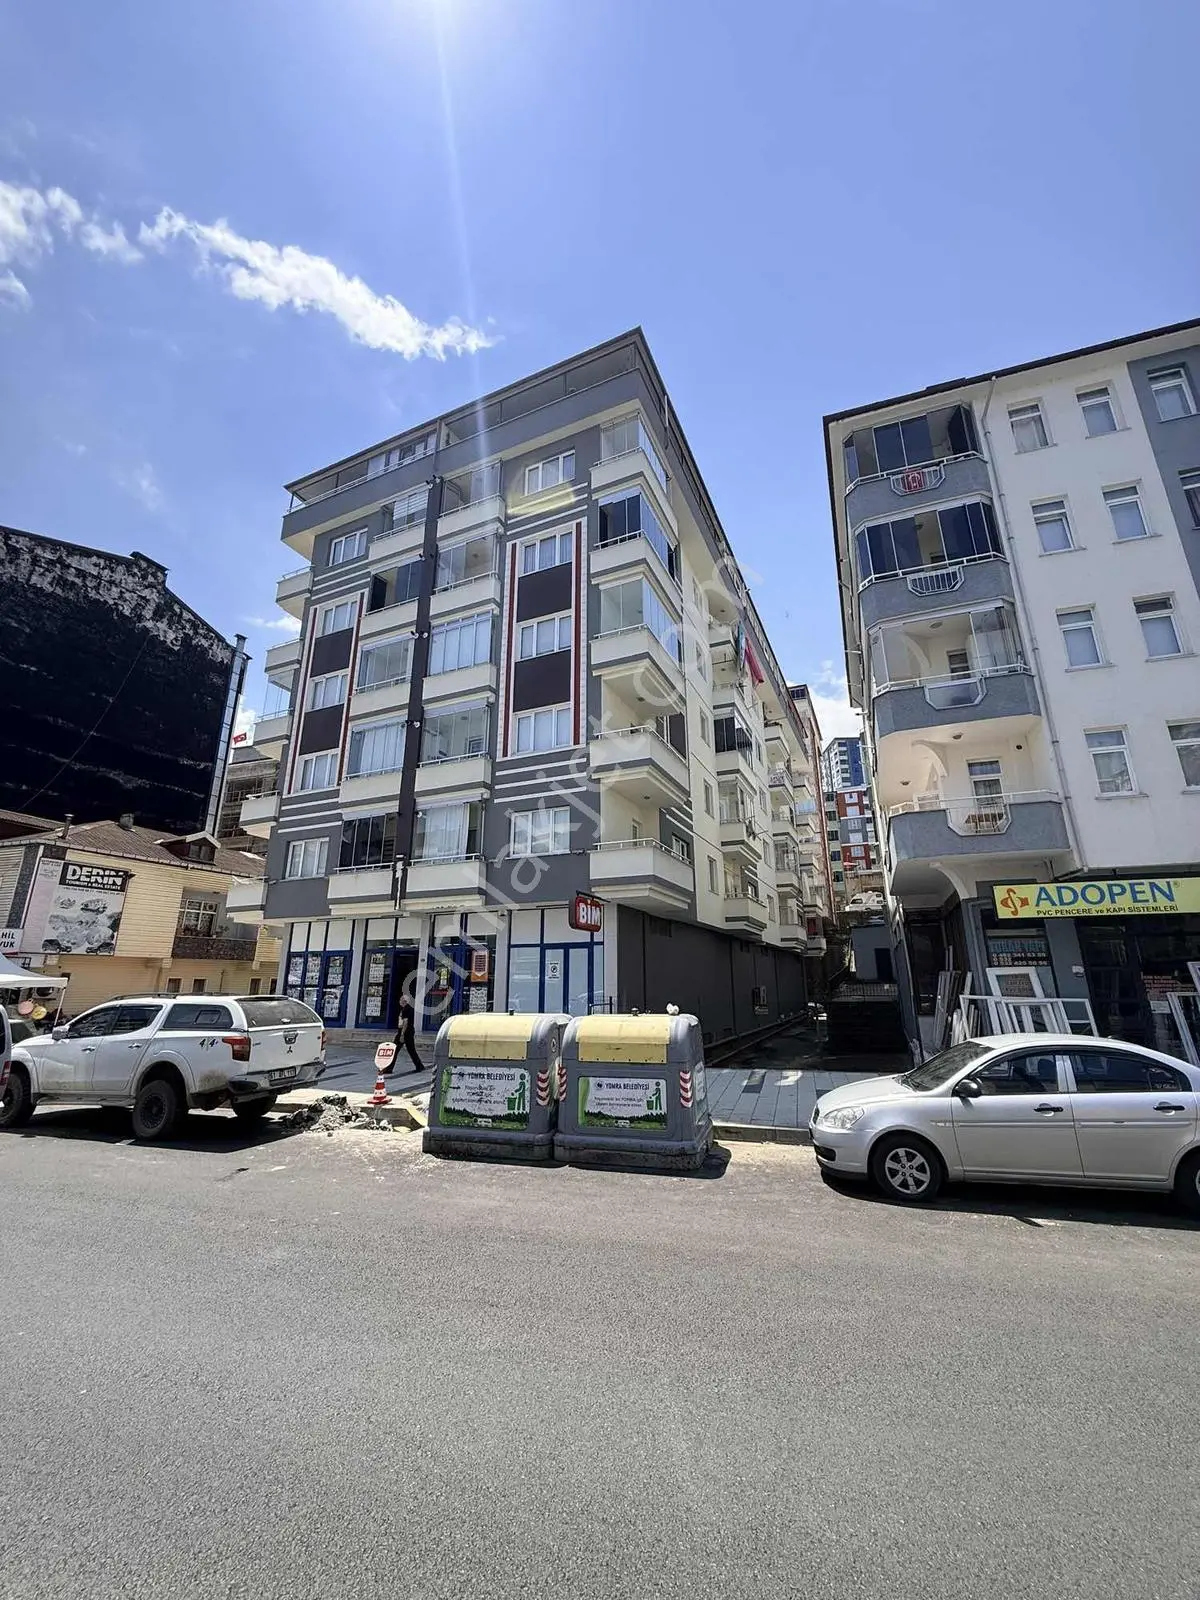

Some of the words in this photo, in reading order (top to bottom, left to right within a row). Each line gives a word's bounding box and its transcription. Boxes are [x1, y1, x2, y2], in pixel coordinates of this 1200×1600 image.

[1035, 881, 1175, 907] ADOPEN
[580, 899, 601, 925] BİM
[1055, 908, 1093, 916] PENCERE
[1127, 905, 1179, 913] SİSTEMLERİ
[623, 1082, 650, 1091] BELEDİYESİ
